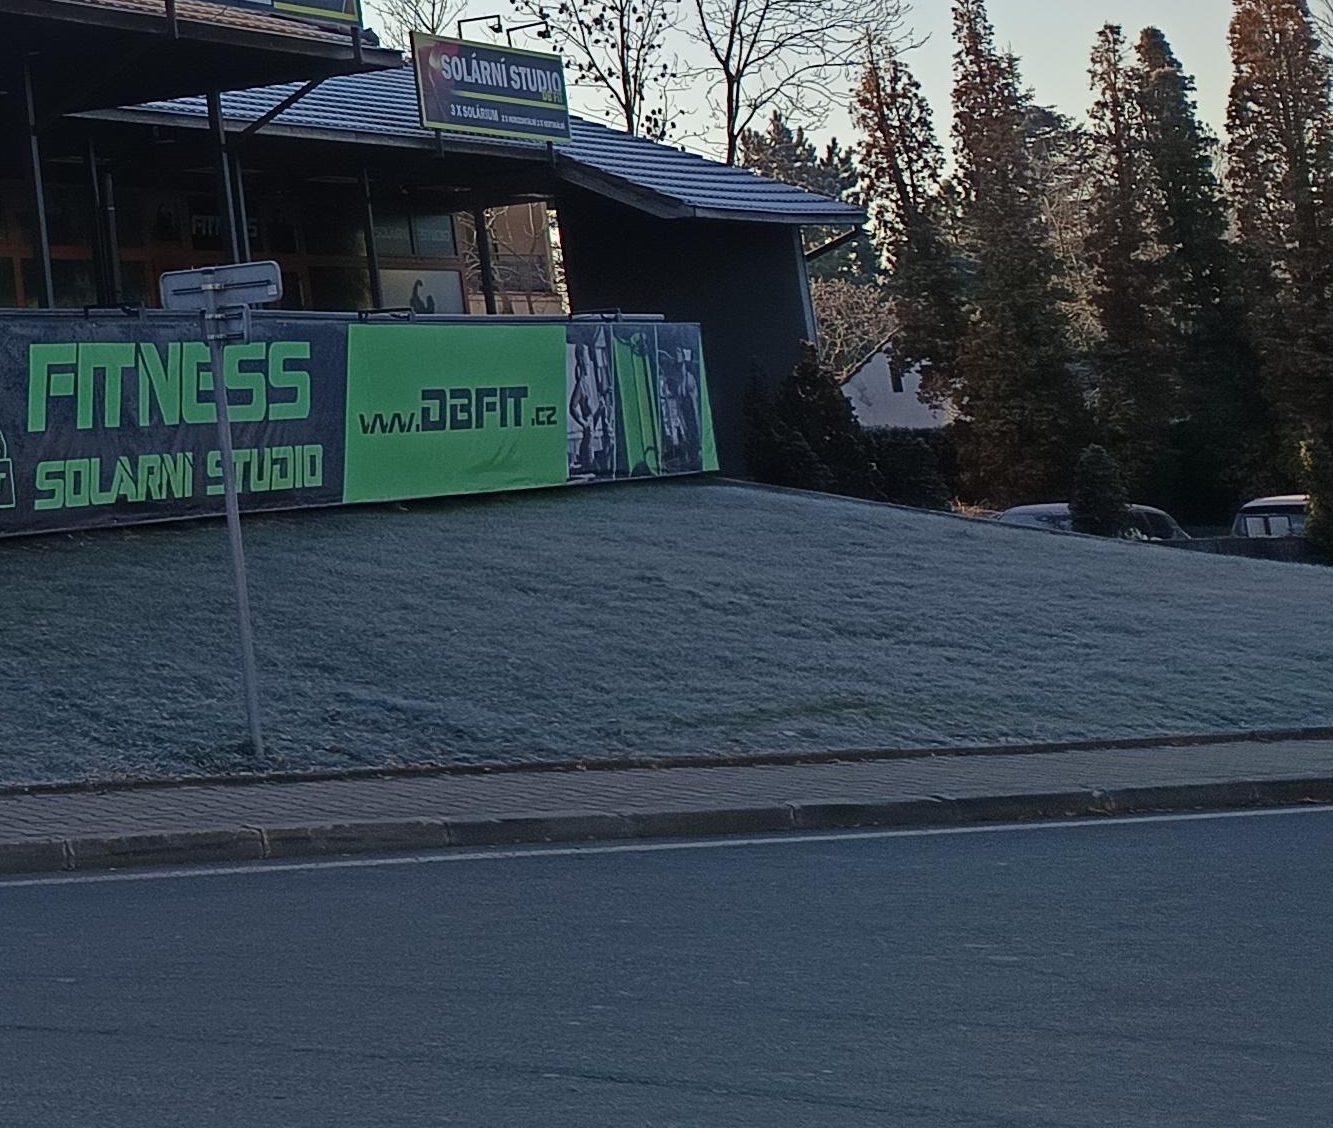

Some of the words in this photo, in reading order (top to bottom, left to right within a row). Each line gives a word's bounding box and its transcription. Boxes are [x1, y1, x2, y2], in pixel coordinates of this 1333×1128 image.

[440, 52, 508, 88] SOLÁRNÍ
[509, 64, 562, 94] STUDIO
[27, 342, 311, 432] FITNESS
[206, 443, 323, 496] STUDIO
